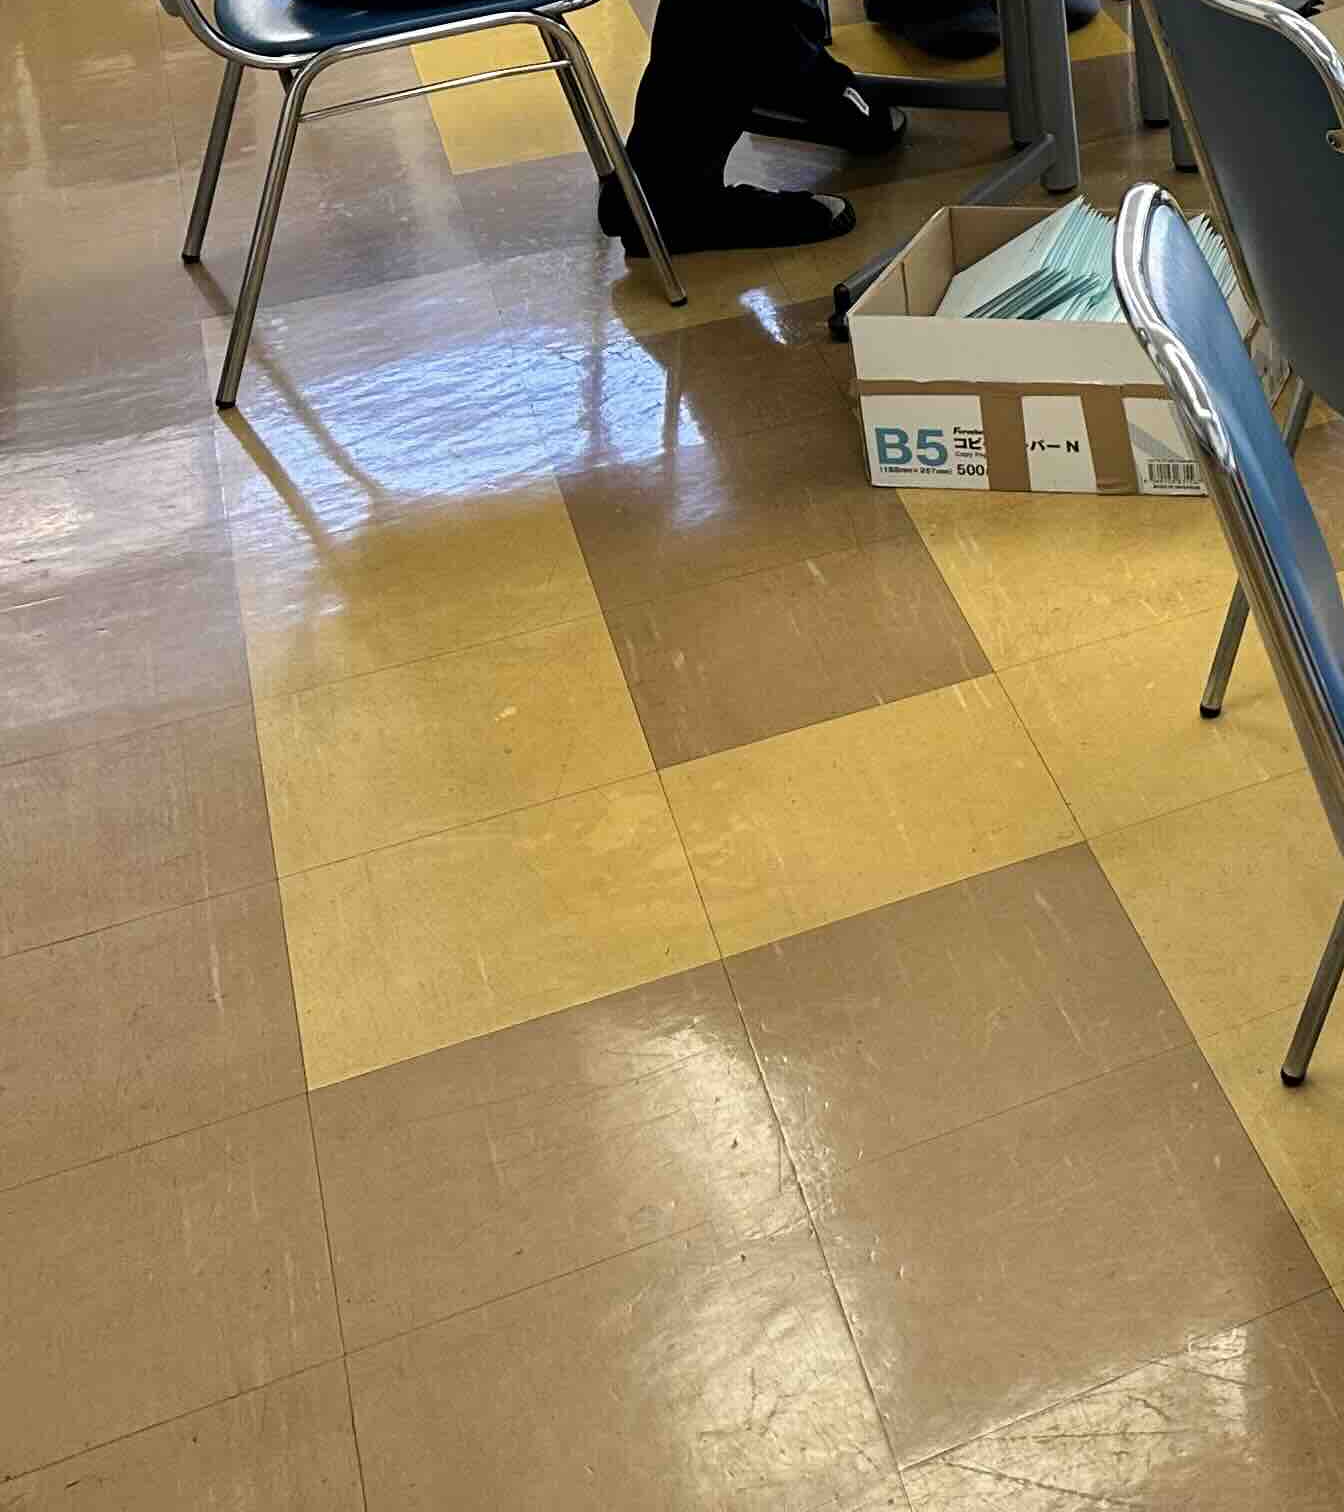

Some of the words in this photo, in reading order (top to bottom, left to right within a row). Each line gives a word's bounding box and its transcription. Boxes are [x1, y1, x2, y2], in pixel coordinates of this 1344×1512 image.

[874, 427, 948, 467] B5
[1066, 440, 1080, 453] N
[956, 464, 985, 476] 500
